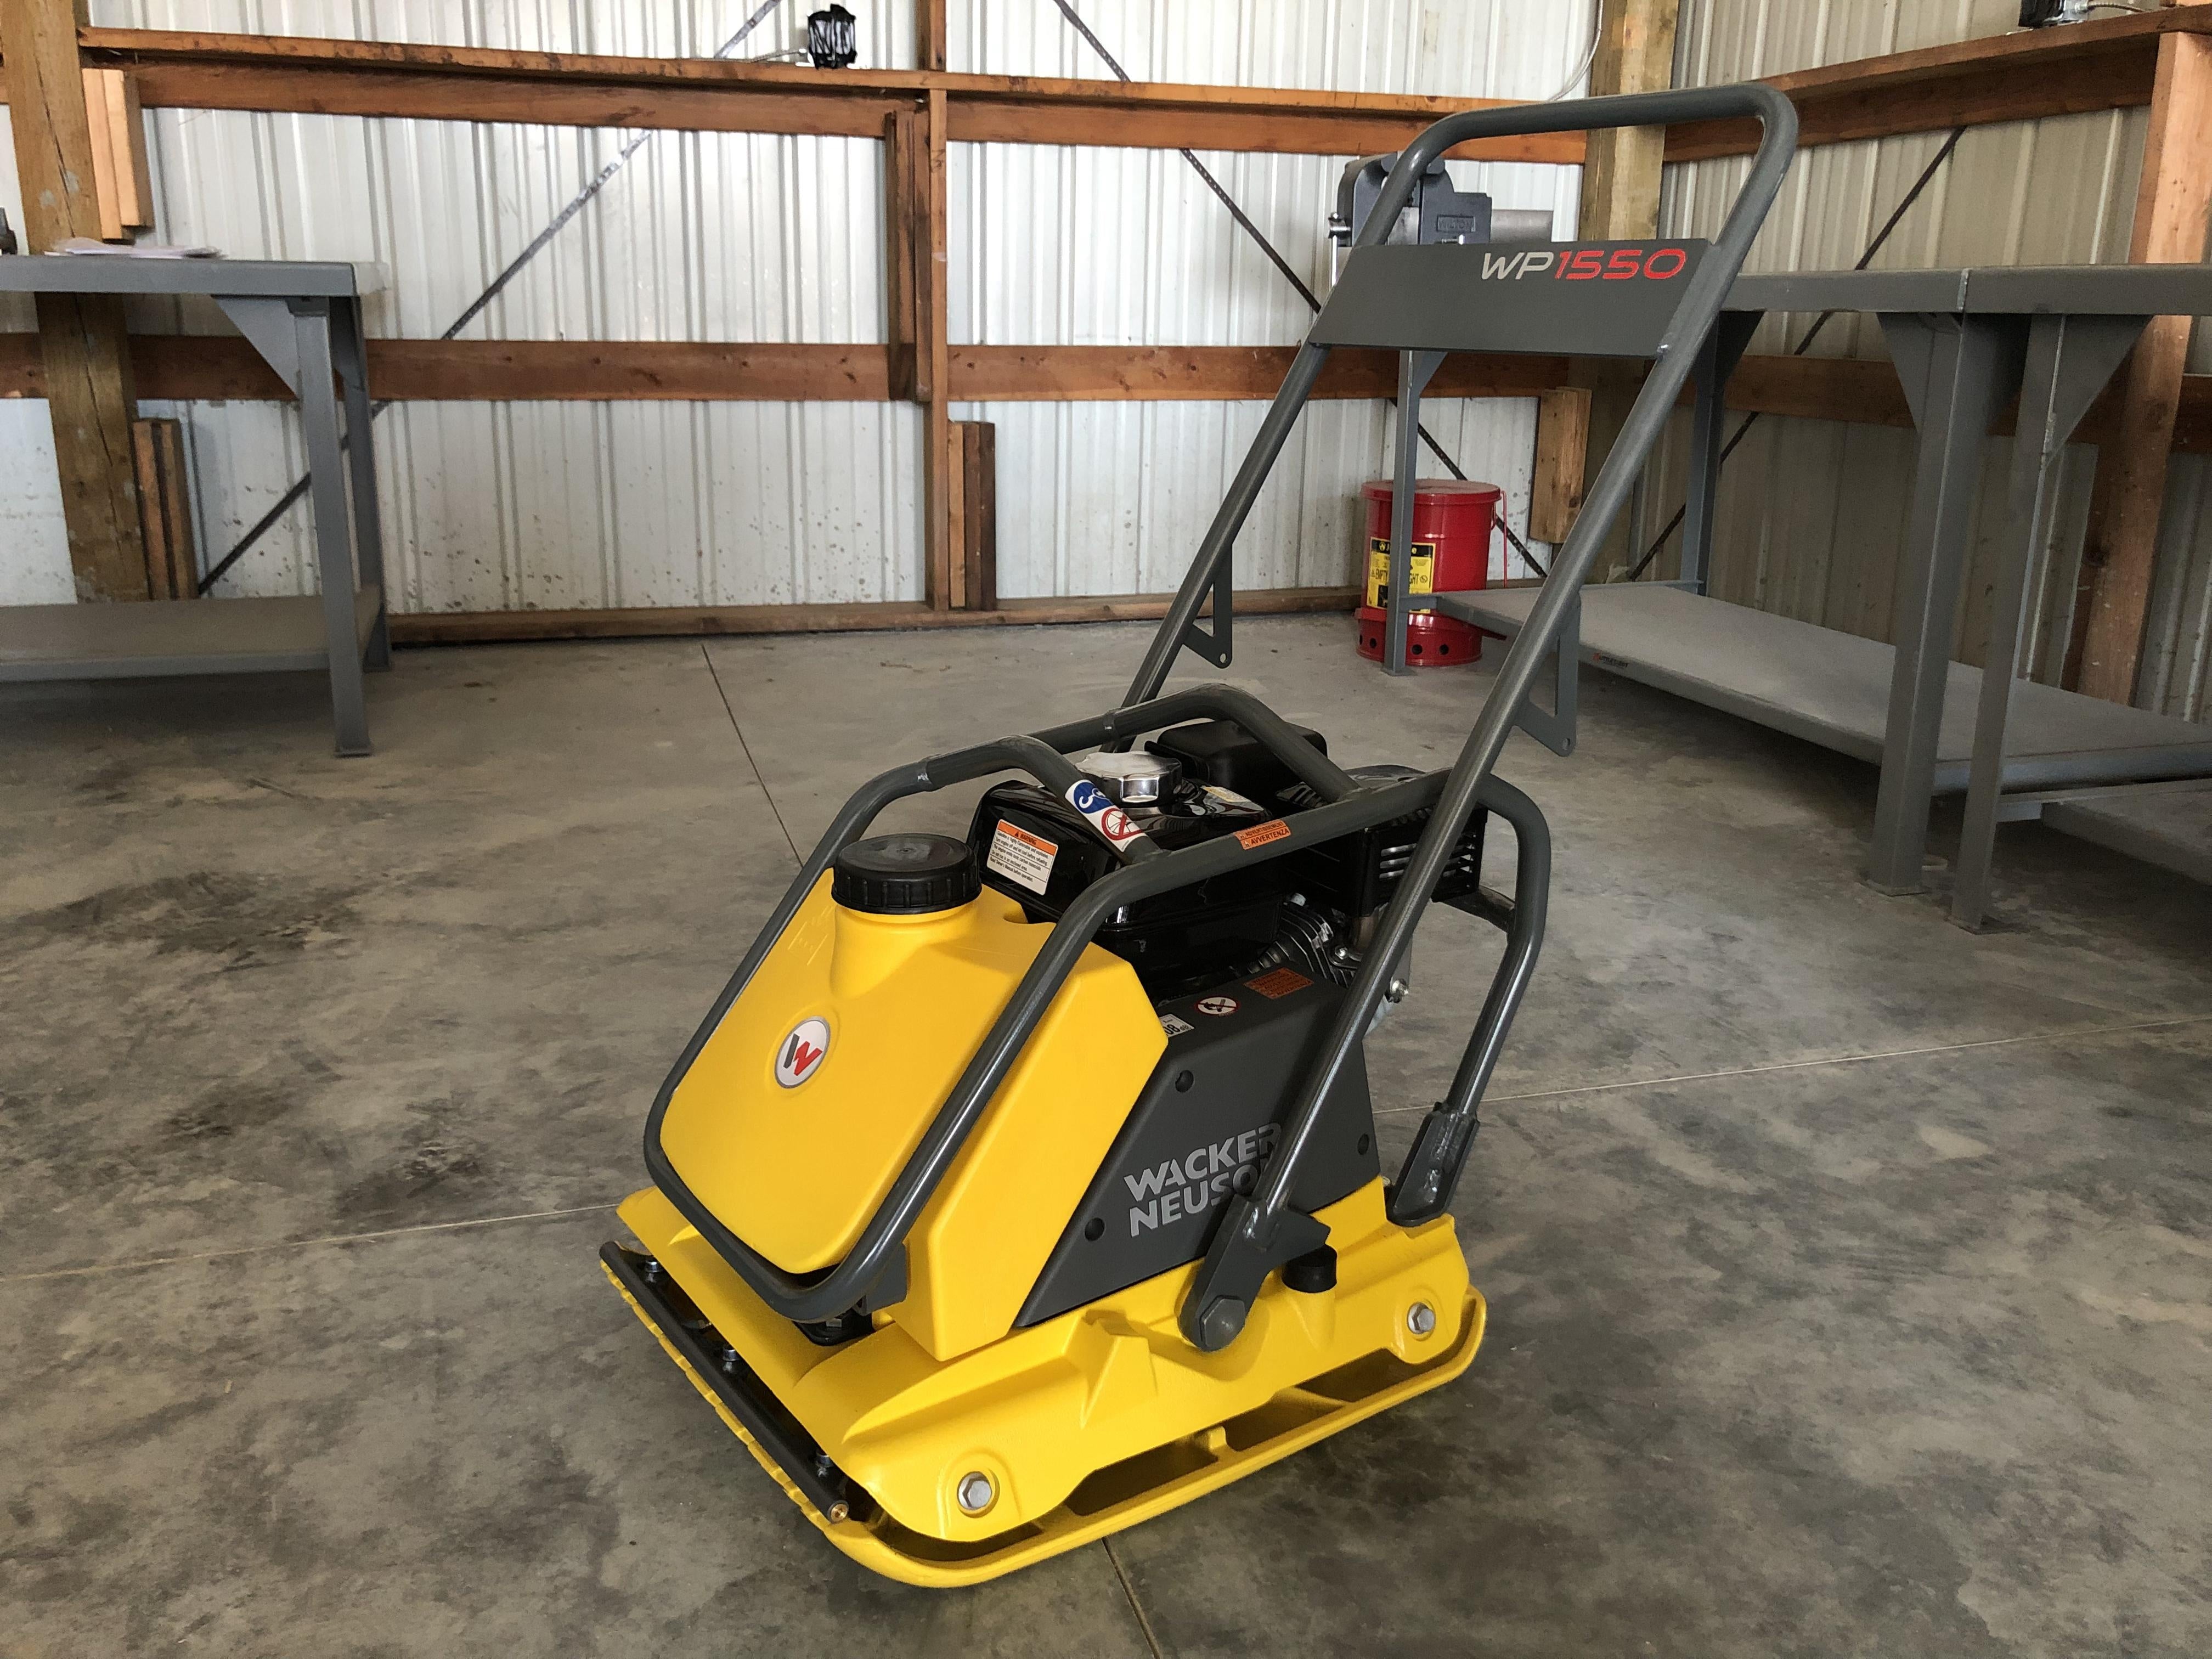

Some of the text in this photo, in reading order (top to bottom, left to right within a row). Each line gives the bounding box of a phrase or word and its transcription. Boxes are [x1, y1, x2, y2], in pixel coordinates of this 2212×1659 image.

[1481, 248, 1686, 280] WP1550
[1020, 833, 1037, 845] WARNING
[1251, 828, 1289, 845] AVVERTENZA
[1124, 1122, 1282, 1202] WACKER
[1129, 1159, 1265, 1238] NEUSO
